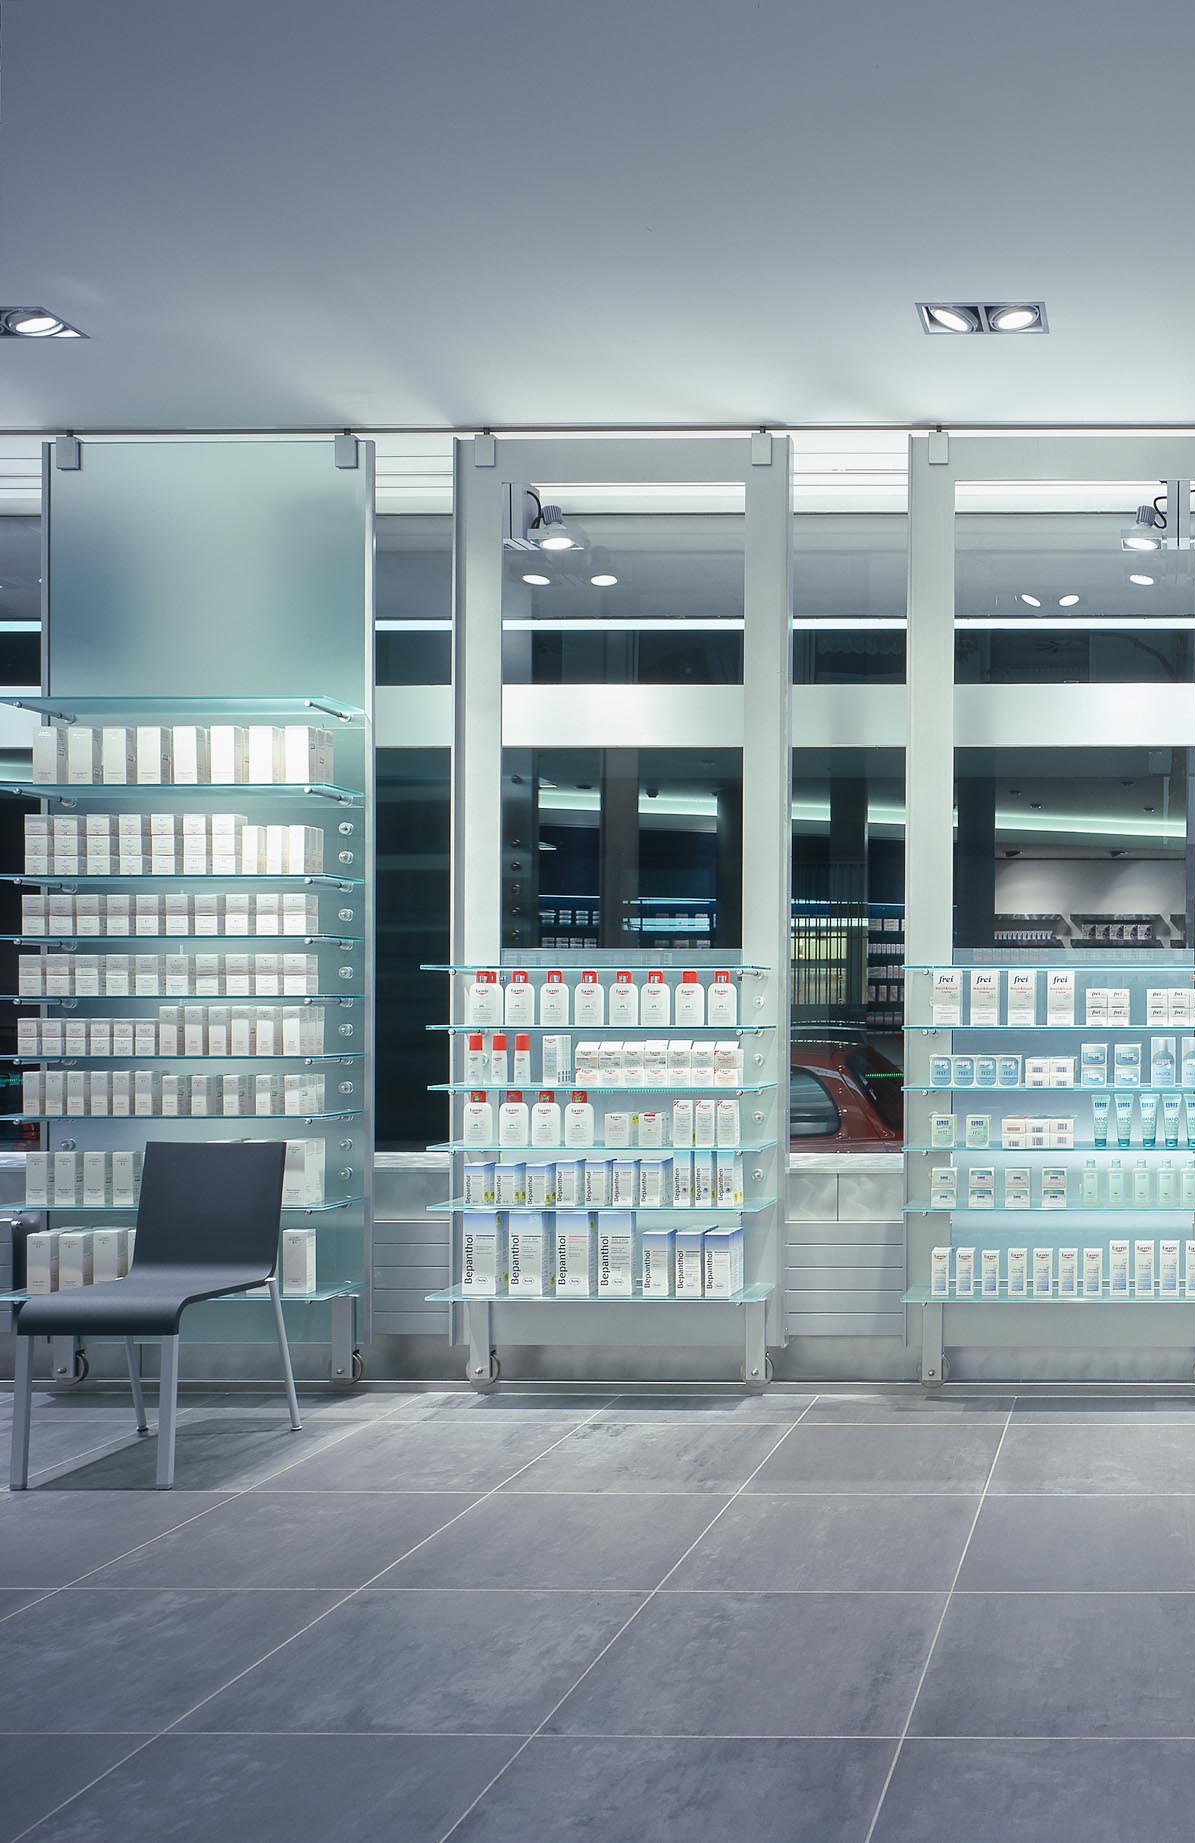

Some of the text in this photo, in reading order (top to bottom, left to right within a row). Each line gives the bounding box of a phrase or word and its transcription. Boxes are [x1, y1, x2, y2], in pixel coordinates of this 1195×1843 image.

[938, 975, 954, 984] frei
[976, 975, 992, 984] frei
[1013, 975, 1029, 984] frei
[1053, 976, 1068, 985] frei
[464, 1234, 474, 1284] Bepanthol
[511, 1234, 521, 1285] Bepanthol
[558, 1235, 568, 1285] Bepanthol
[600, 1236, 610, 1286] Bepanthol
[644, 1250, 652, 1288] Bepanthol
[677, 1250, 685, 1289] Bepanthol
[706, 1251, 714, 1289] Bepanthol
